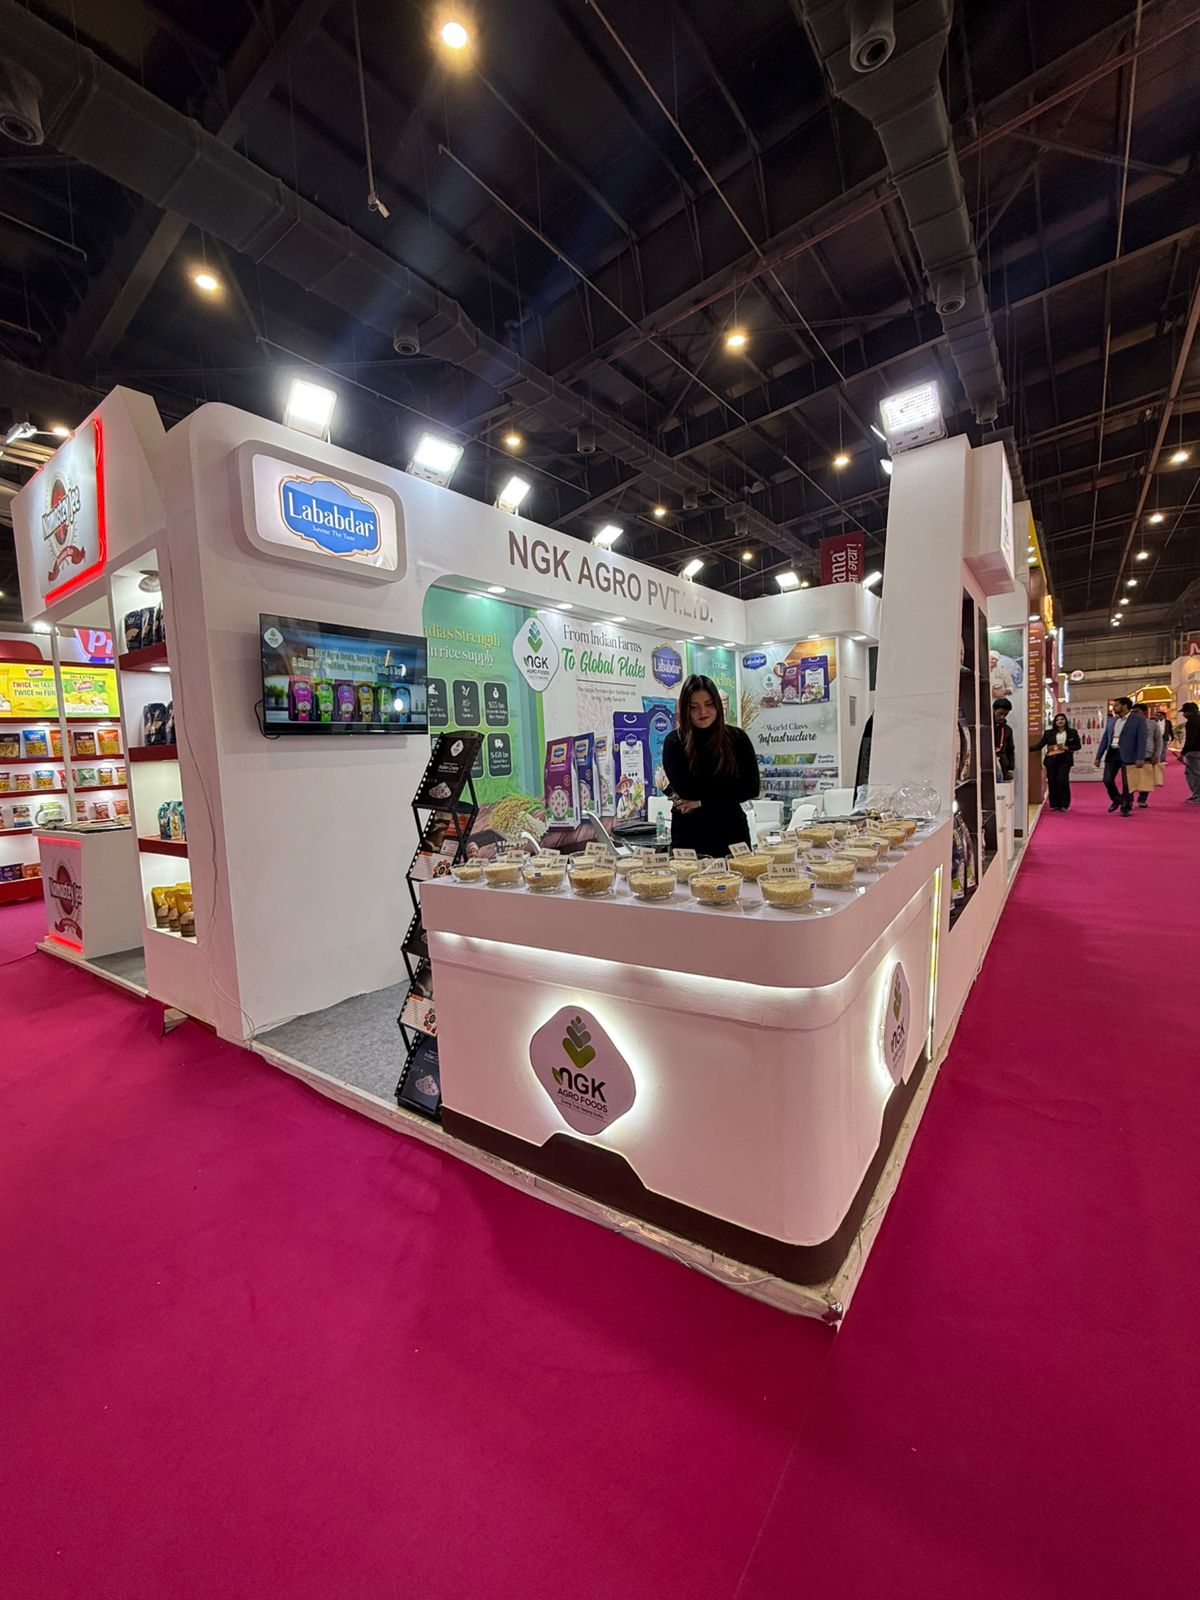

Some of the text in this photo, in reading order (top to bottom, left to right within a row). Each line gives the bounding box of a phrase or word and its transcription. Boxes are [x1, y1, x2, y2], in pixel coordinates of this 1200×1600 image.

[287, 491, 374, 537] Lababdar
[508, 530, 571, 582] NGK
[578, 556, 642, 602] AGRO
[831, 550, 847, 583] ana
[563, 624, 643, 653] From Indian Farms
[439, 645, 462, 659] rice
[463, 649, 494, 668] supply
[561, 647, 646, 678] To Global Plates
[757, 730, 817, 746] Infrastructure
[766, 722, 808, 731] World Class
[557, 1087, 608, 1113] AGRO FOODS
